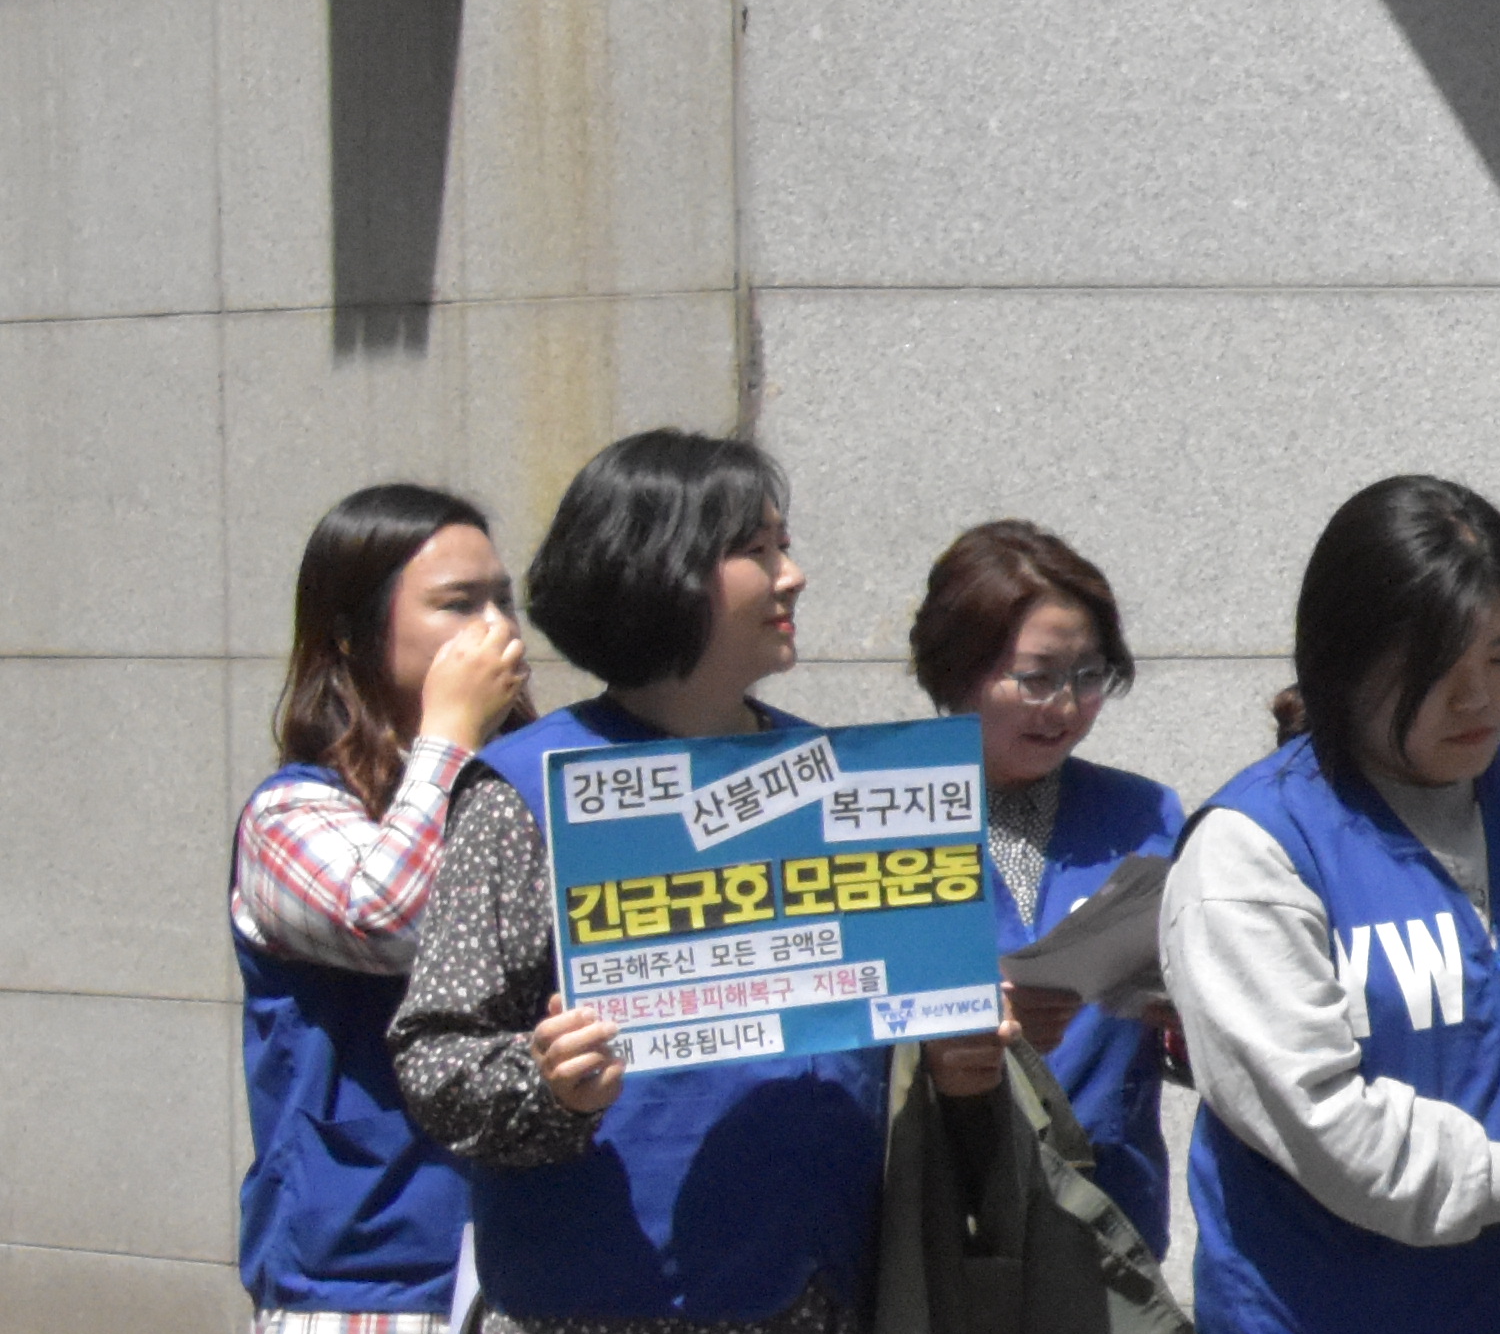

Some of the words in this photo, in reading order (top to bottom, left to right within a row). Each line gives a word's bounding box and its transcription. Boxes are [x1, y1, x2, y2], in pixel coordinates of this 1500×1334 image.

[573, 763, 685, 814] 강원도
[692, 741, 836, 837] 산불피해
[829, 781, 974, 830] 복구지원
[568, 862, 775, 943] 긴급구호
[783, 844, 981, 917] 모금운동
[579, 947, 697, 986] 모금해주신
[711, 938, 757, 967] 모든
[769, 927, 841, 962] 금액은
[813, 964, 881, 997] 지원을
[648, 1023, 775, 1060] 사용됩니다.
